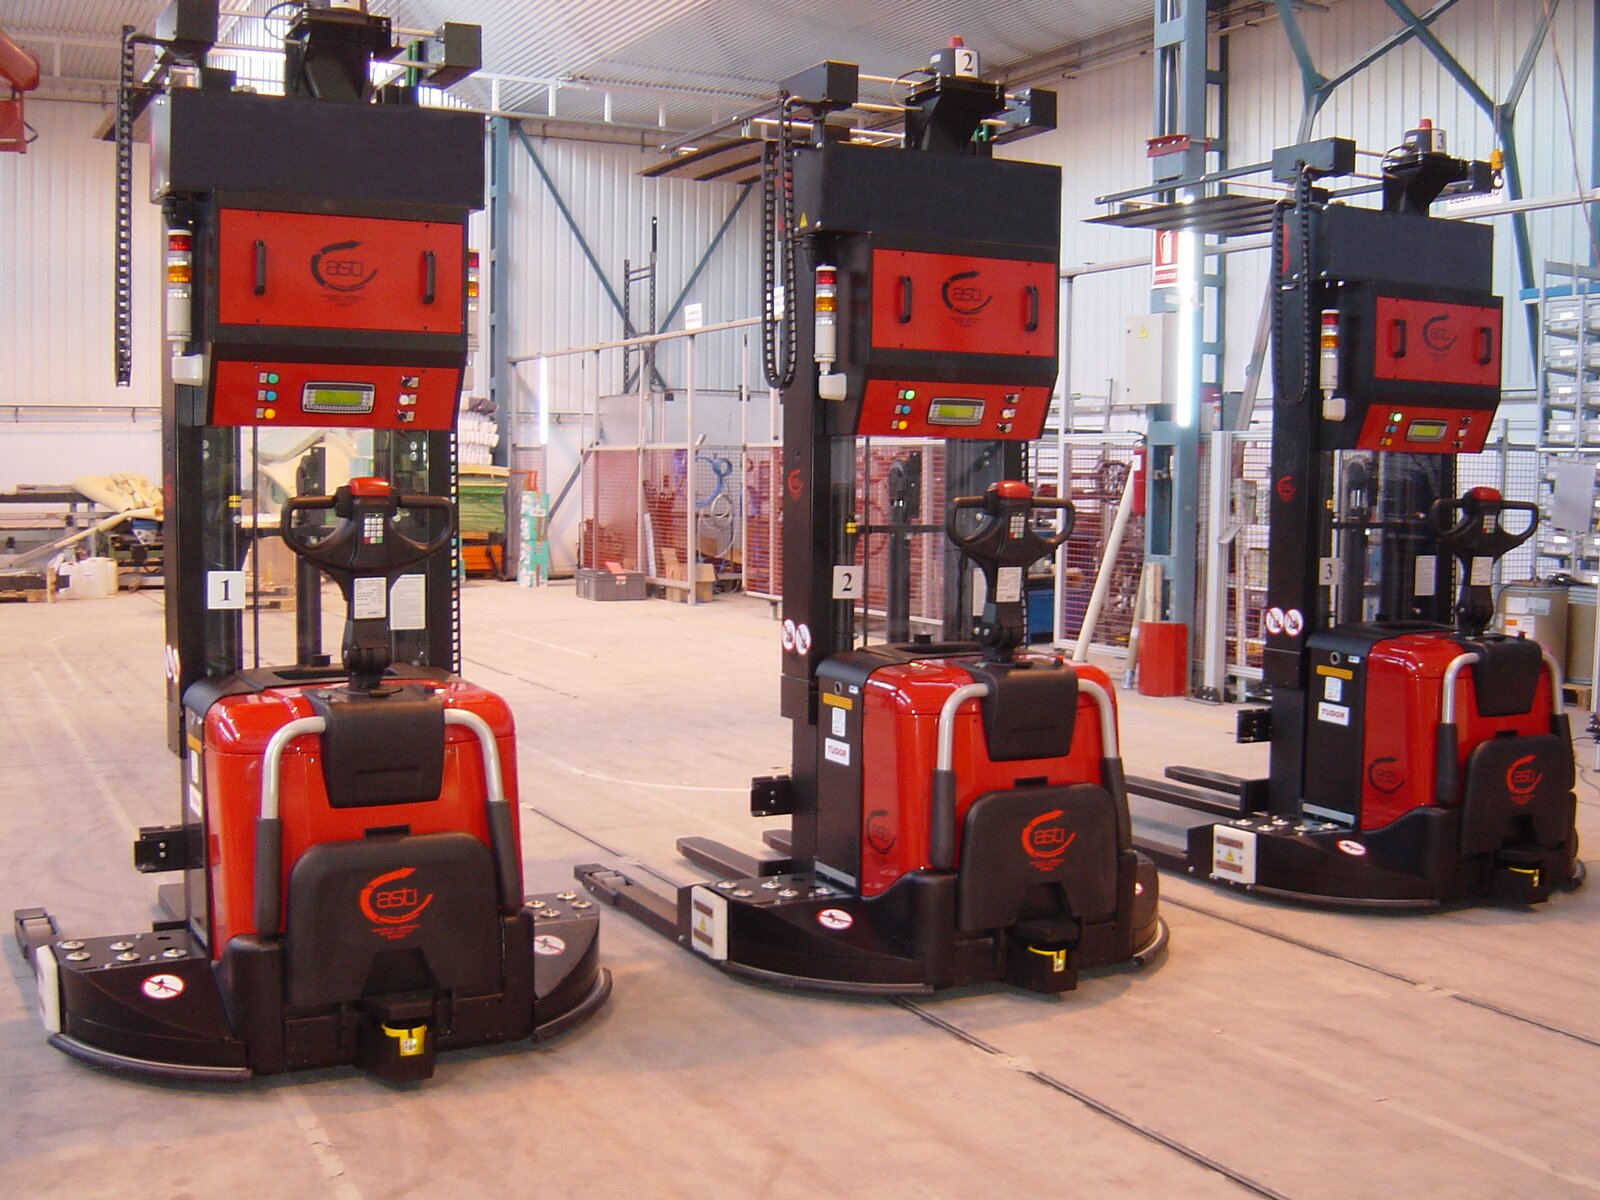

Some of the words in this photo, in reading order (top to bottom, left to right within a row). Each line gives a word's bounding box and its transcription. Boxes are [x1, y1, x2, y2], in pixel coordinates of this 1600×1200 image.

[962, 52, 974, 73] 2
[1436, 132, 1445, 150] 3
[1324, 562, 1333, 580] 3
[220, 579, 231, 602] 1
[842, 572, 853, 592] 2
[1322, 707, 1345, 719] TUDOR
[828, 745, 847, 758] TUDOR
[376, 887, 417, 909] asti
